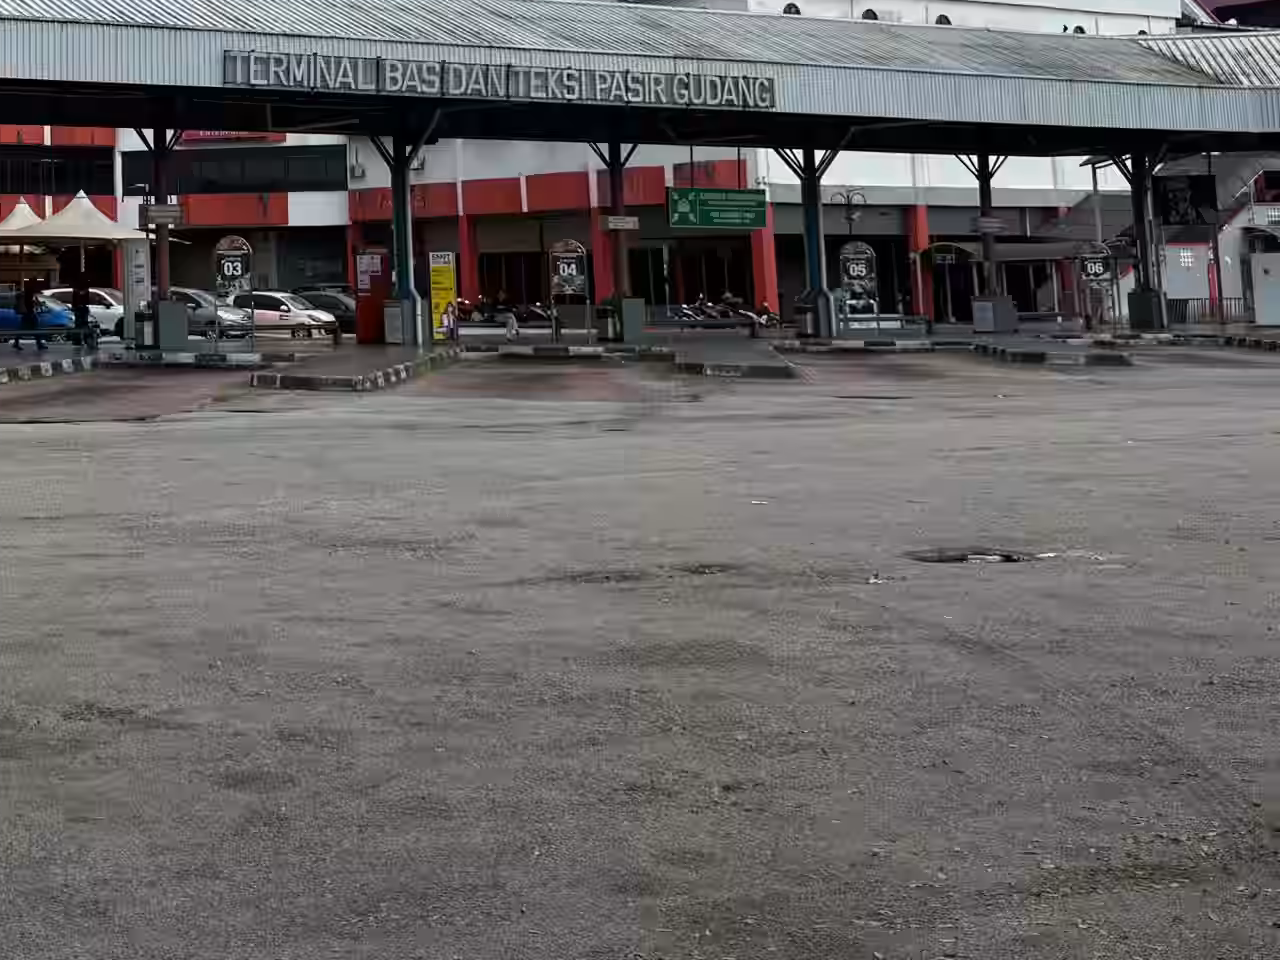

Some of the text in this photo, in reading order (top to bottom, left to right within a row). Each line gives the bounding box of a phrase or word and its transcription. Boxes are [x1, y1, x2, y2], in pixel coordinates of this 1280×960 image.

[230, 51, 770, 108] TERMINAL BAS DAN TEKSI PASIR GUDANG
[223, 261, 242, 276] 03
[559, 263, 577, 276] 04
[849, 263, 867, 277] 05
[1086, 262, 1104, 274] 06
